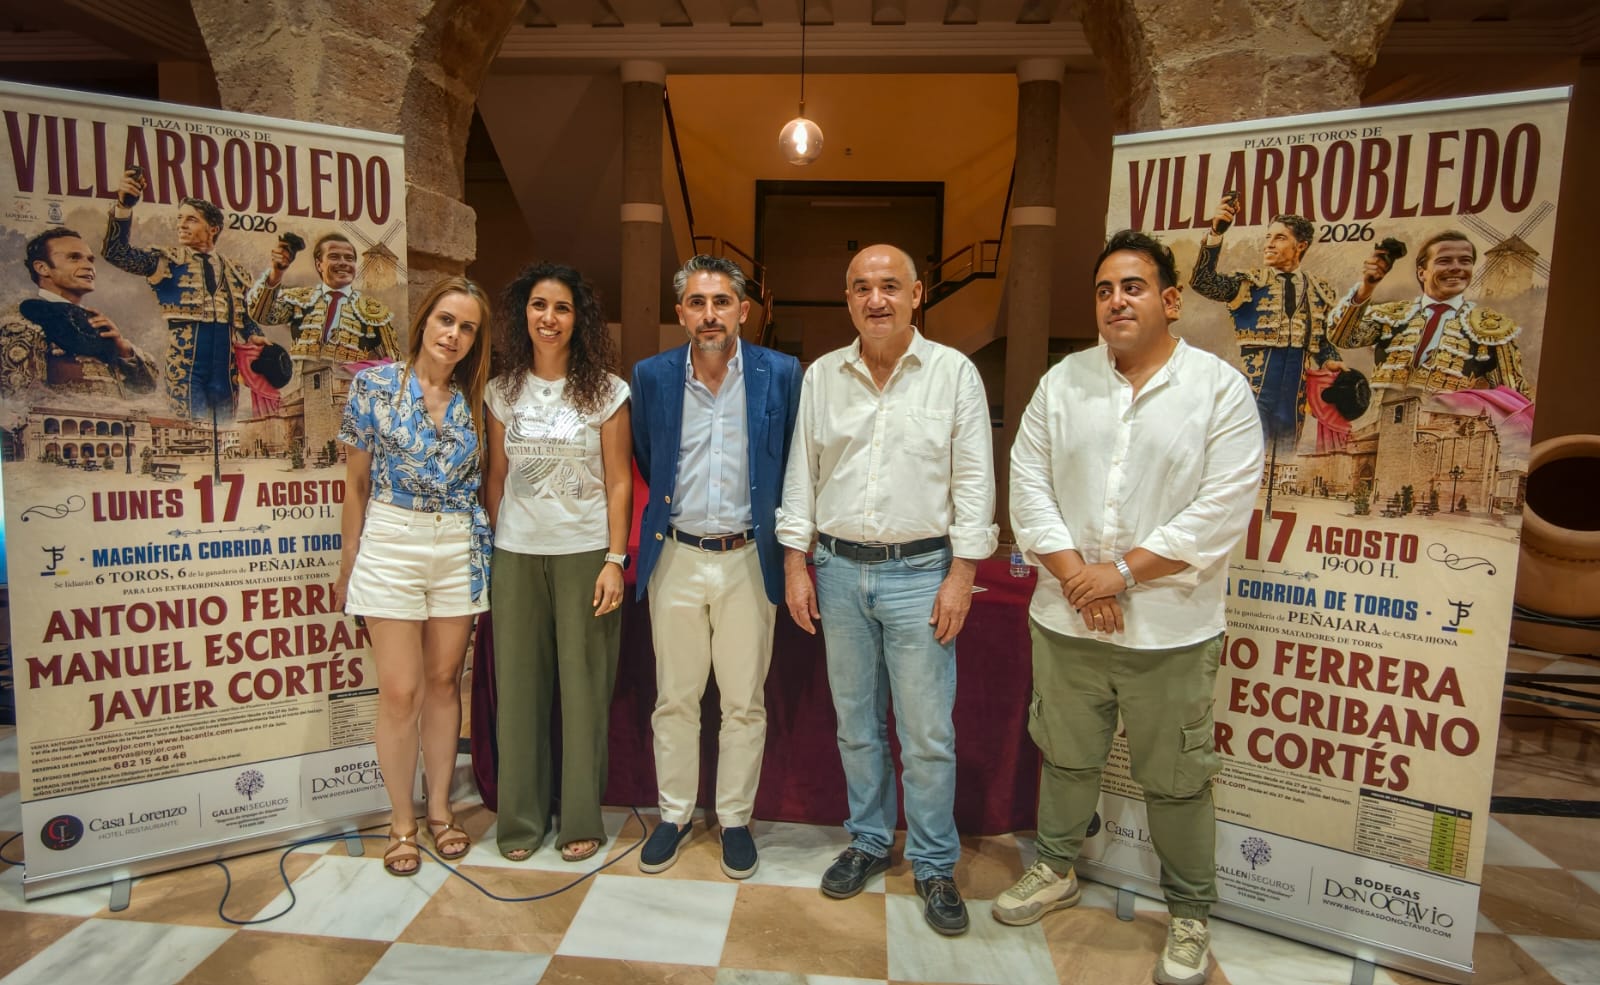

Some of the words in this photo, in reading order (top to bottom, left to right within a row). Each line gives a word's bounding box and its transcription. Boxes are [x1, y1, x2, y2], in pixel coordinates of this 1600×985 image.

[141, 117, 181, 130] PLAZA
[184, 122, 204, 134] DE
[206, 125, 250, 139] TOROS
[254, 131, 272, 142] DE
[1244, 136, 1283, 149] PLAZA
[1286, 134, 1305, 144] DE
[1309, 129, 1357, 143] TOROS
[1362, 126, 1382, 137] DE
[3, 110, 391, 225] VILLARROBLEDO
[1128, 122, 1541, 232] VILLARROBLEDO
[228, 213, 277, 233] 2026
[1318, 222, 1375, 243] 2026
[92, 488, 184, 522] LUNES
[194, 473, 245, 524] 17
[256, 480, 346, 508] AGOSTO
[272, 505, 315, 521] 19:00
[320, 505, 335, 518] H.
[92, 542, 192, 568] MAGNÍFICA
[198, 538, 272, 560] CORRIDA
[278, 536, 296, 554] DE
[302, 533, 342, 552] TORO
[1244, 509, 1297, 563] 17
[1305, 524, 1419, 564] AGOSTO
[96, 574, 105, 585] 6
[109, 569, 174, 583] TOROS,
[178, 567, 187, 578] 6
[249, 556, 326, 573] PEÑAJARA
[1321, 555, 1374, 576] 19:00
[1380, 564, 1399, 579] H.
[123, 587, 145, 596] PARA
[147, 585, 163, 594] LOS
[165, 579, 244, 593] EXTRAORDINARIOS
[245, 575, 291, 585] MATADORES
[306, 571, 330, 579] TOROS
[42, 596, 228, 643] ANTONIO
[241, 583, 336, 622] FERR
[1238, 578, 1317, 608] CORRIDA
[1324, 589, 1347, 611] DE
[1354, 594, 1418, 621] TOROS
[1226, 620, 1280, 634] ORDINARIOS
[1281, 628, 1336, 644] MATADORES
[1352, 638, 1384, 650] TOROS
[1287, 610, 1380, 636] PEÑAJARA
[1393, 631, 1424, 642] CASTA
[25, 641, 192, 690] MANUEL
[204, 620, 373, 668] ESCRIBAN
[1273, 640, 1466, 708] FERRERA
[88, 679, 218, 731] JAVIER
[228, 652, 364, 704] CORTÉS
[1228, 677, 1481, 757] ESCRIBANO
[113, 759, 137, 770] 682
[140, 757, 152, 766] 15
[155, 753, 170, 763] 48
[172, 751, 187, 760] 48
[334, 759, 381, 774] BODEGA
[1247, 727, 1411, 792] CORTÉS
[312, 784, 384, 801] WWW.BODEGASDONOCTA
[89, 818, 124, 833] Casa
[129, 804, 187, 825] Lorenzo
[1105, 820, 1134, 839] Casa
[1324, 878, 1367, 904] DON
[1370, 892, 1454, 928] OCTAVIO
[1354, 876, 1421, 900] BODEGAS
[1322, 898, 1452, 939] WWW.BODEGASDONOCTAVIO.COM
